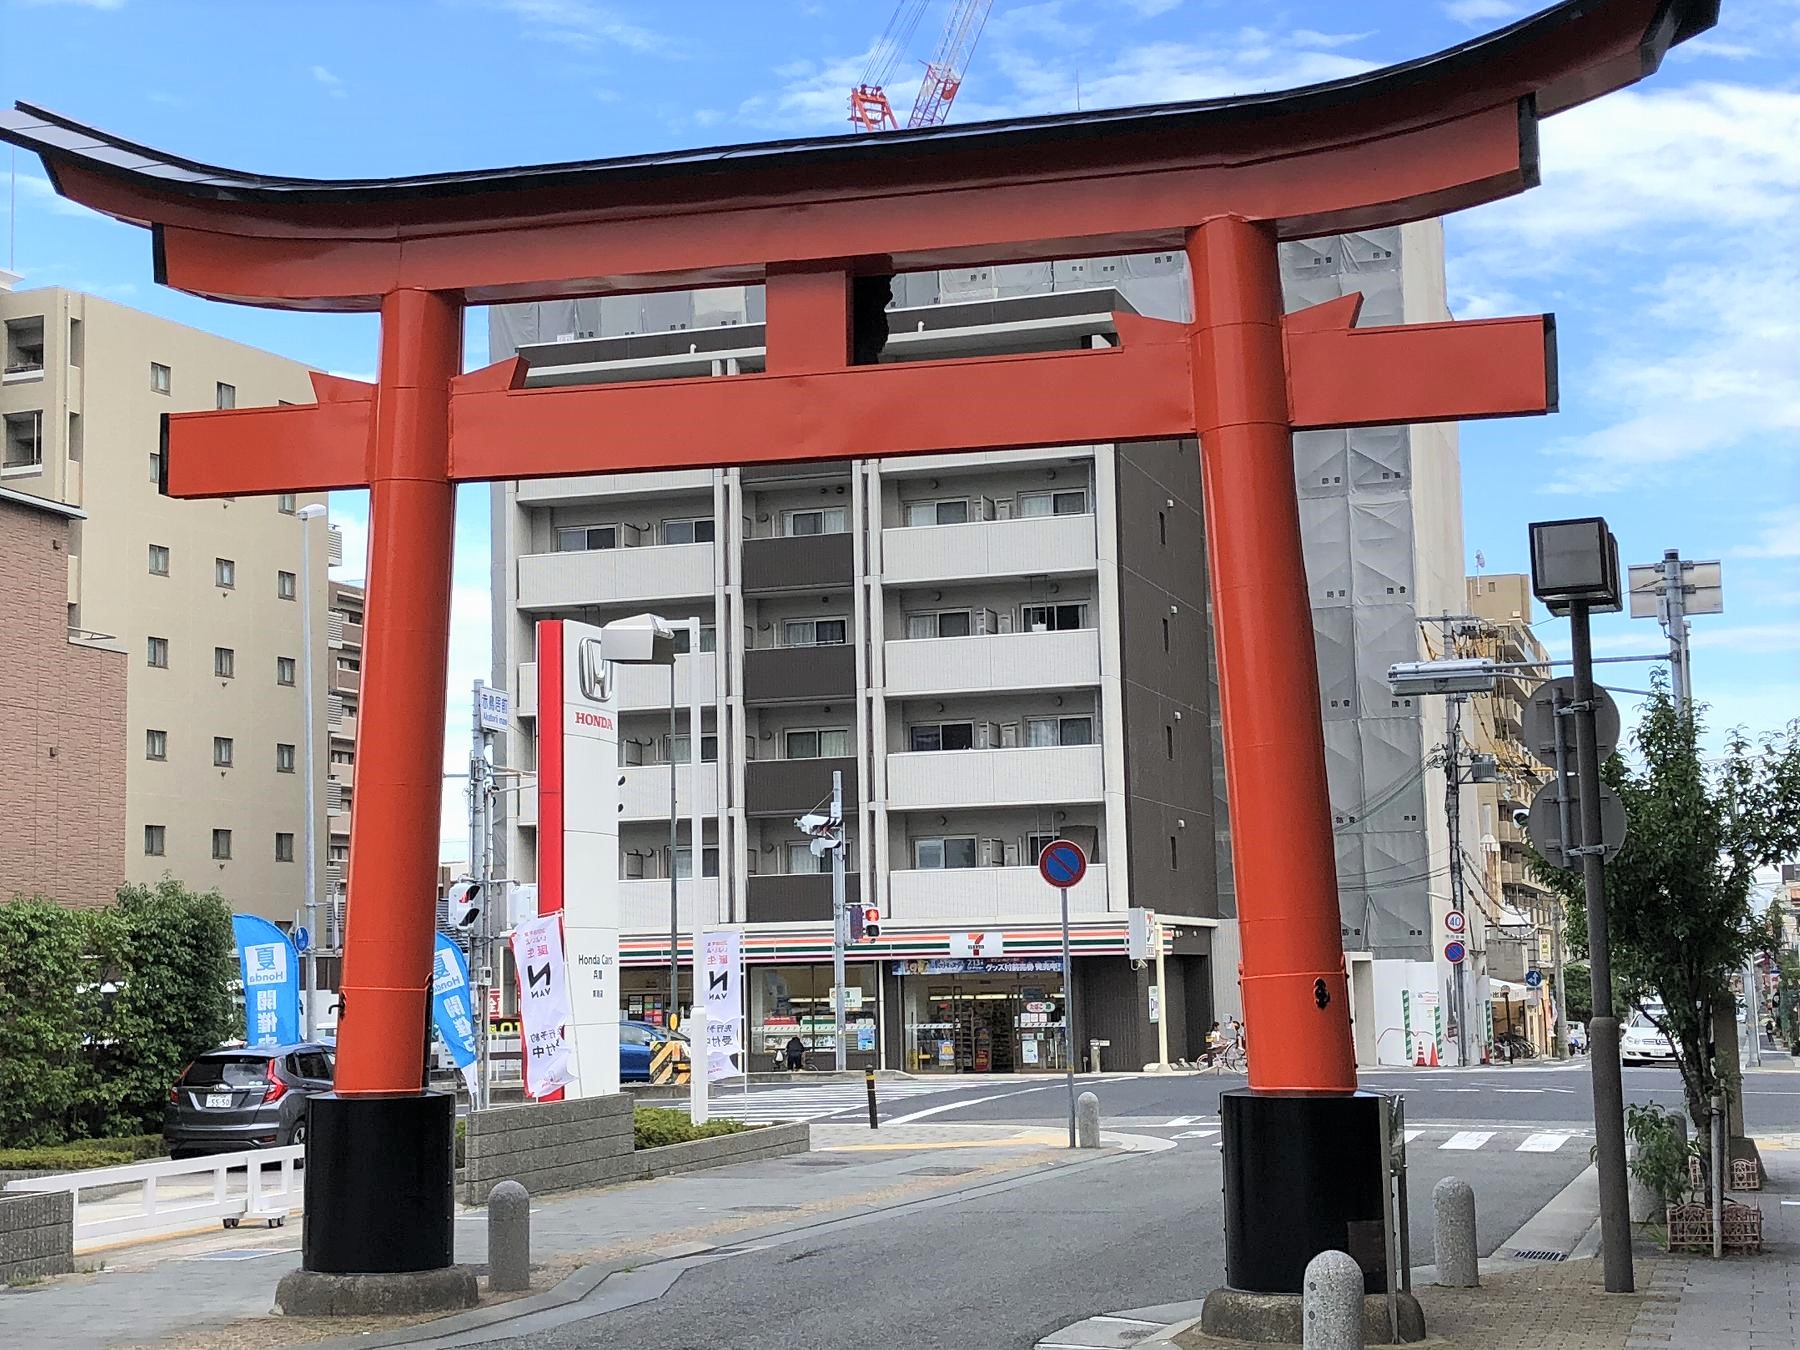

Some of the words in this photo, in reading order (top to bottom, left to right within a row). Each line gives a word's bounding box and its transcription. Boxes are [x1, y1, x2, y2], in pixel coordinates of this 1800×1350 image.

[575, 712, 614, 730] HONDA
[1449, 916, 1461, 927] 40
[578, 954, 601, 965] Honda
[601, 954, 613, 965] Cars
